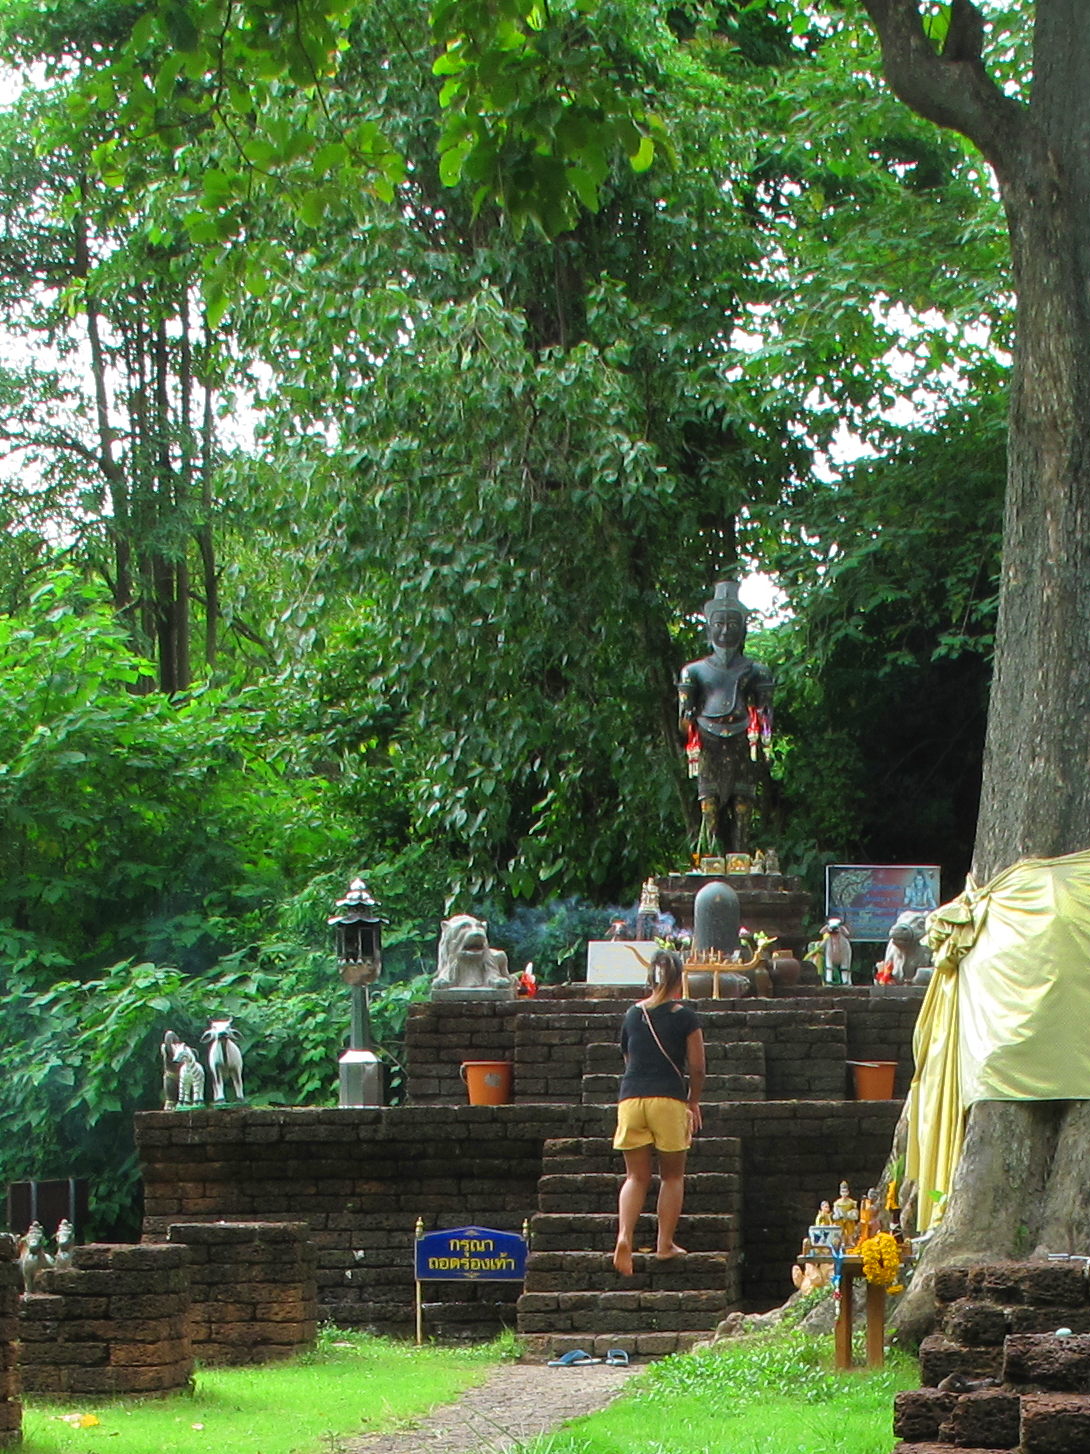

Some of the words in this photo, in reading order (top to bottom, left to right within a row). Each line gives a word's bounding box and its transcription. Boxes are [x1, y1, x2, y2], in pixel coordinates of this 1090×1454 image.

[449, 1239, 494, 1257] กรุณา
[428, 1252, 515, 1270] ถอดรองเท้า
